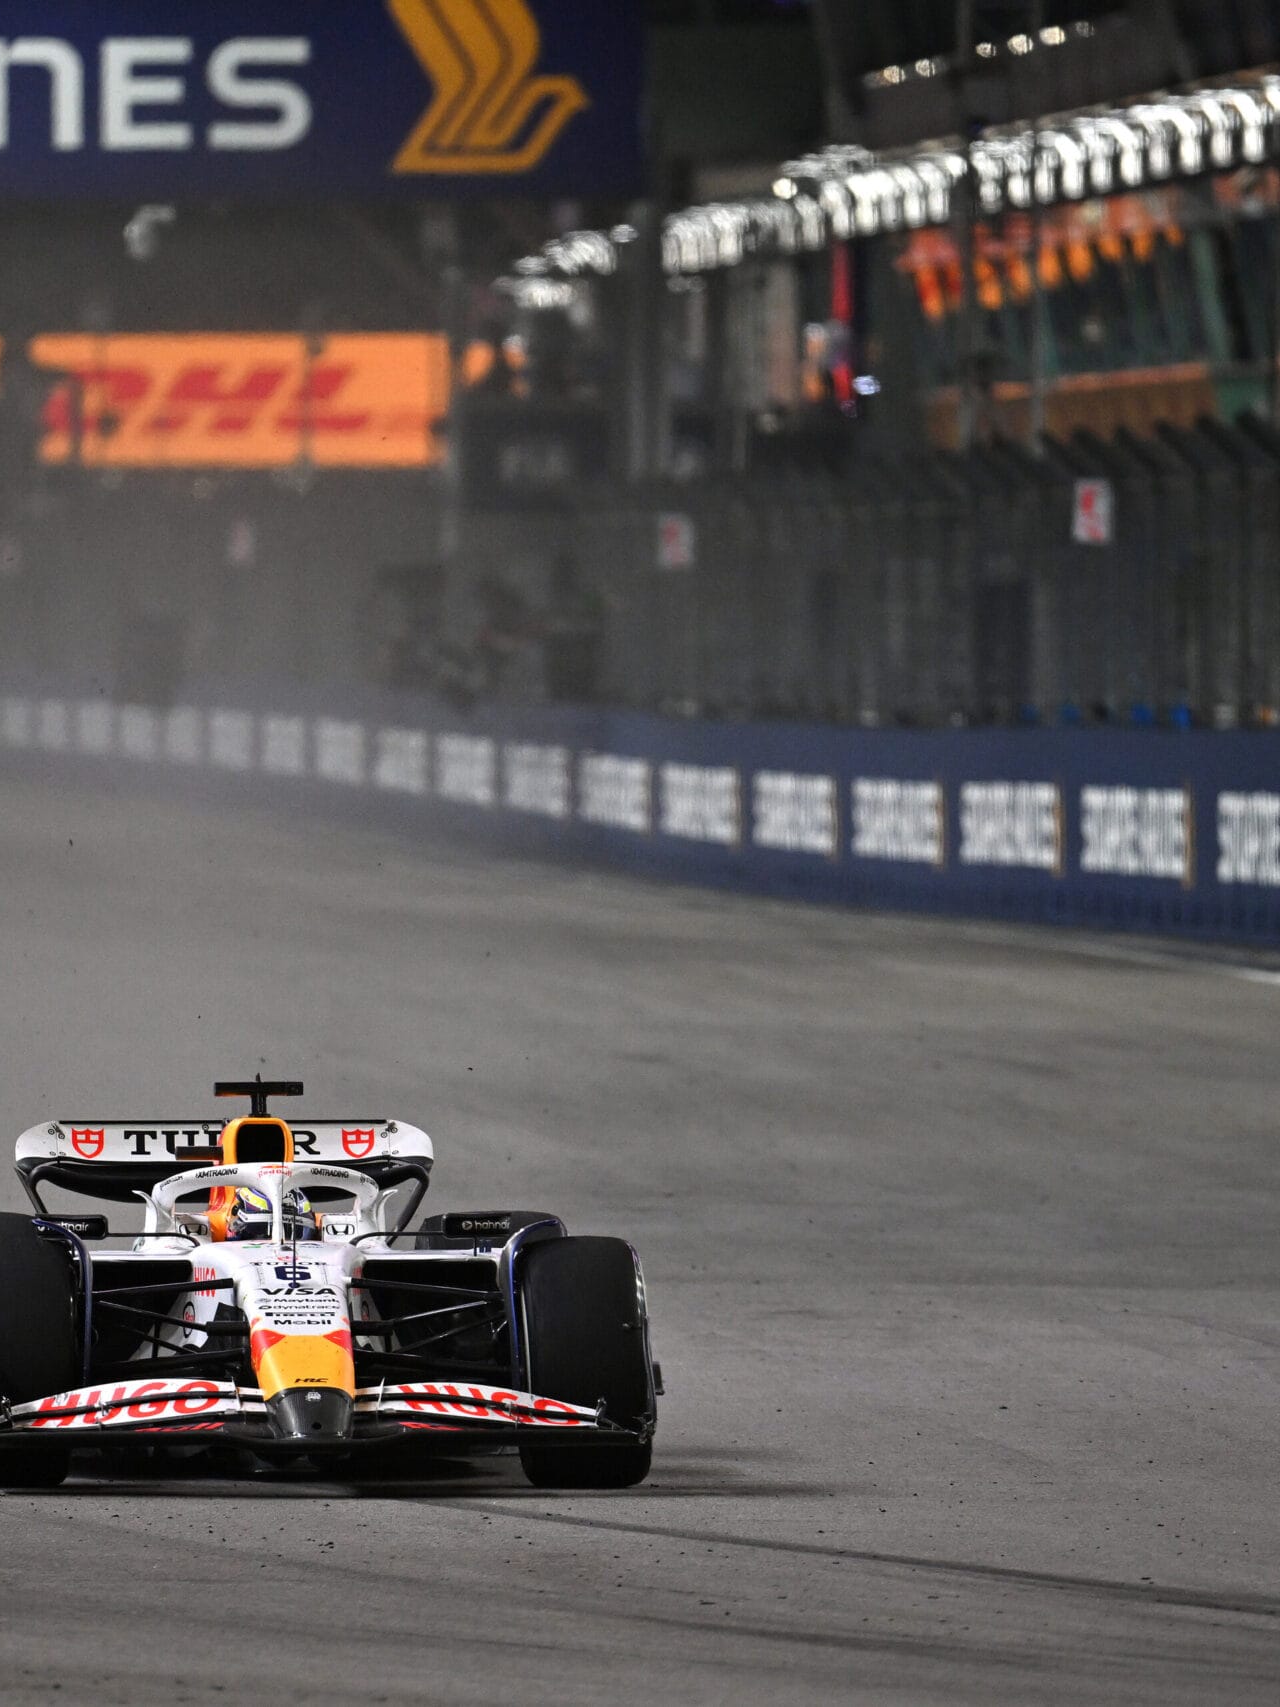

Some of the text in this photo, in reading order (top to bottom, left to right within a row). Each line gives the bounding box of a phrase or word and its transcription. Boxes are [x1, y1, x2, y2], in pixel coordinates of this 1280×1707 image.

[43, 366, 372, 434] DHL
[124, 1130, 320, 1155] TUR
[274, 1266, 312, 1281] 6
[31, 1381, 221, 1428] HUGO
[397, 1384, 580, 1426] HUGO
